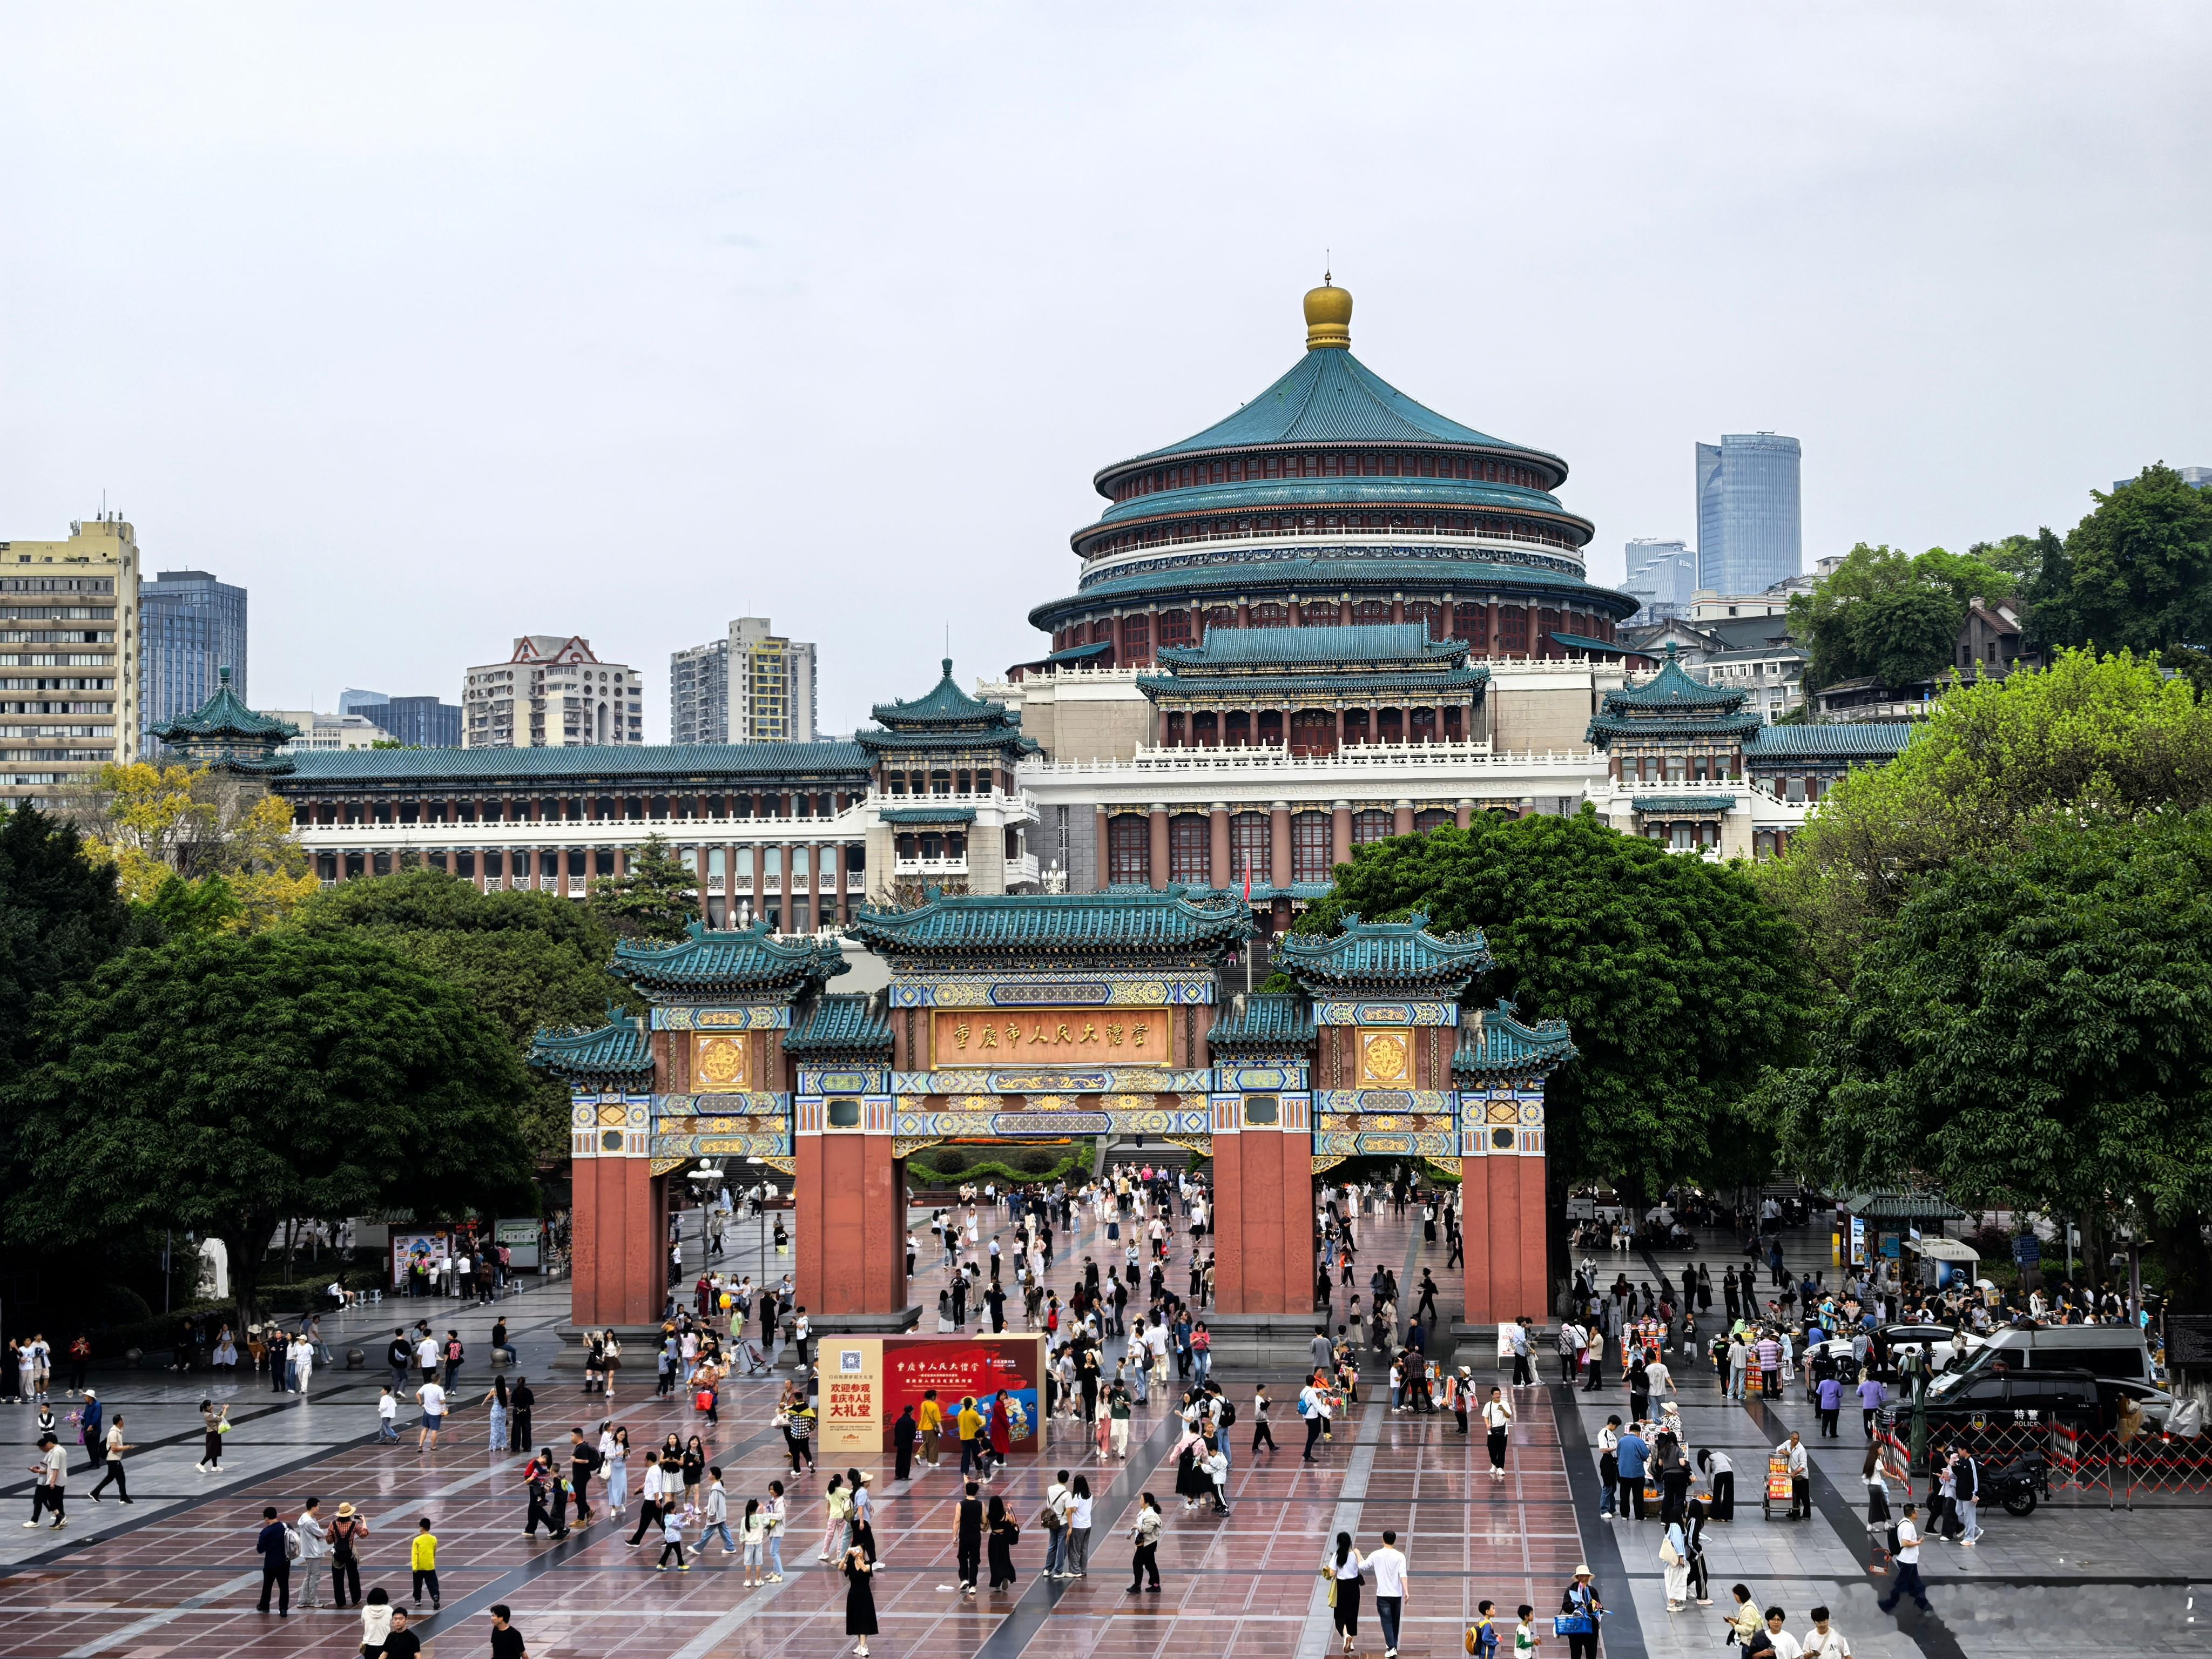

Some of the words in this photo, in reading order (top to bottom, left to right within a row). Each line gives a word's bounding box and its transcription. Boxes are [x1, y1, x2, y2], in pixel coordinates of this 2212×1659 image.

[954, 1023, 1148, 1049] 重慶市人民大禮堂
[831, 1384, 871, 1392] 欢迎参观
[830, 1394, 871, 1403] 重庆市人民
[830, 1404, 871, 1417] 大礼堂
[2014, 1409, 2038, 1420] 特警
